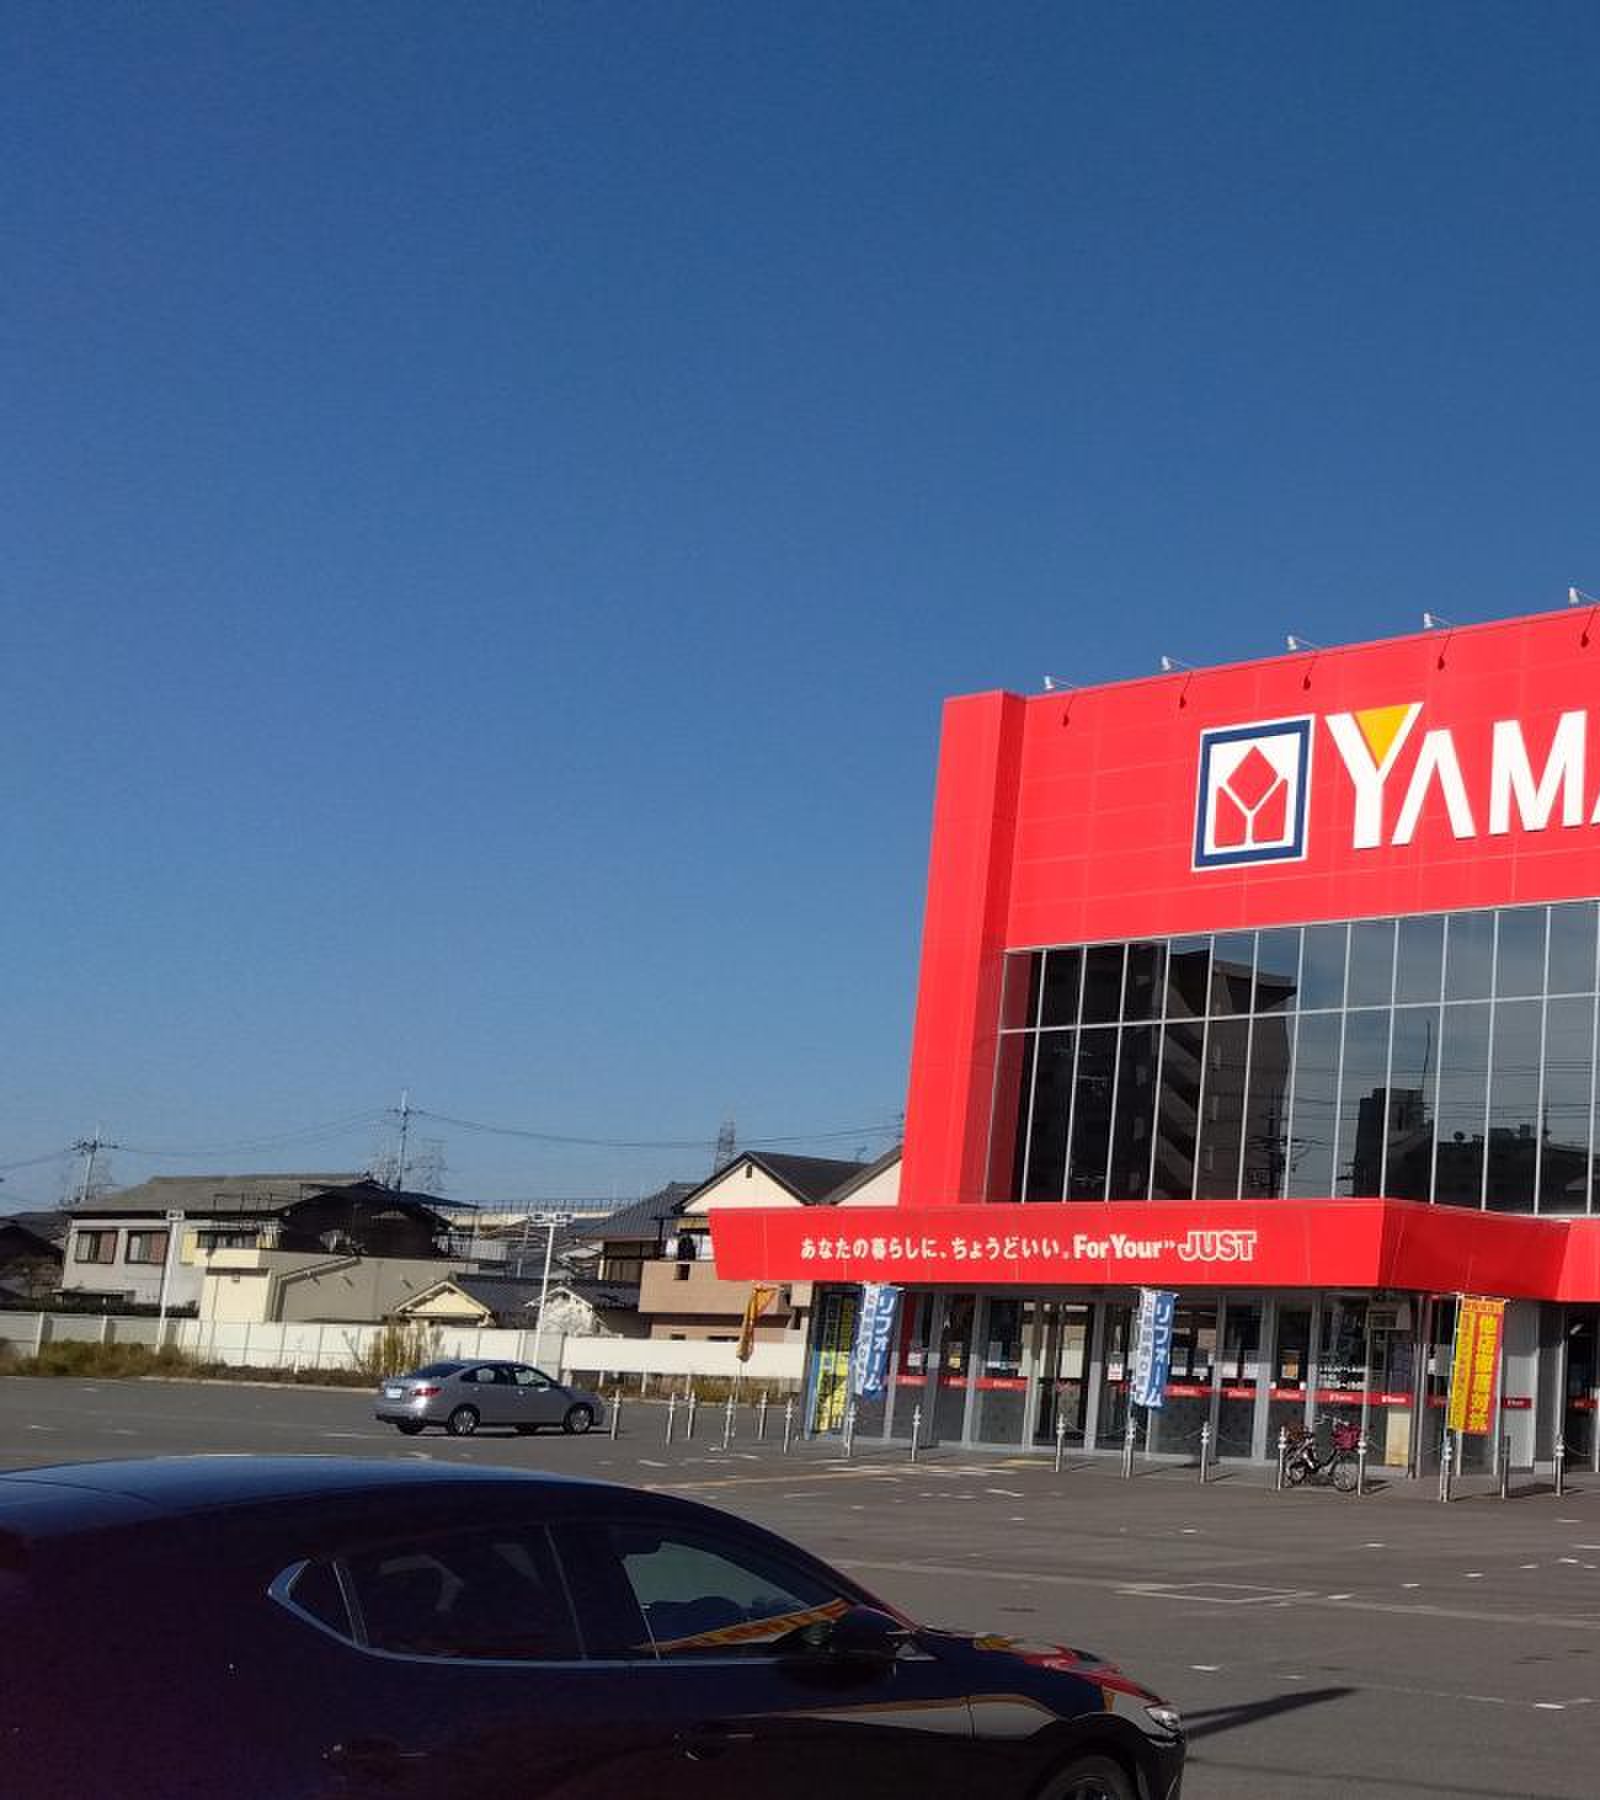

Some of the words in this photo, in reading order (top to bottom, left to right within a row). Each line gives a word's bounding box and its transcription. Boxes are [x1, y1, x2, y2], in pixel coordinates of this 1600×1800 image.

[1177, 1230, 1258, 1262] JUST
[863, 1296, 896, 1392] リフォーム
[1144, 1302, 1171, 1408] リフォーム
